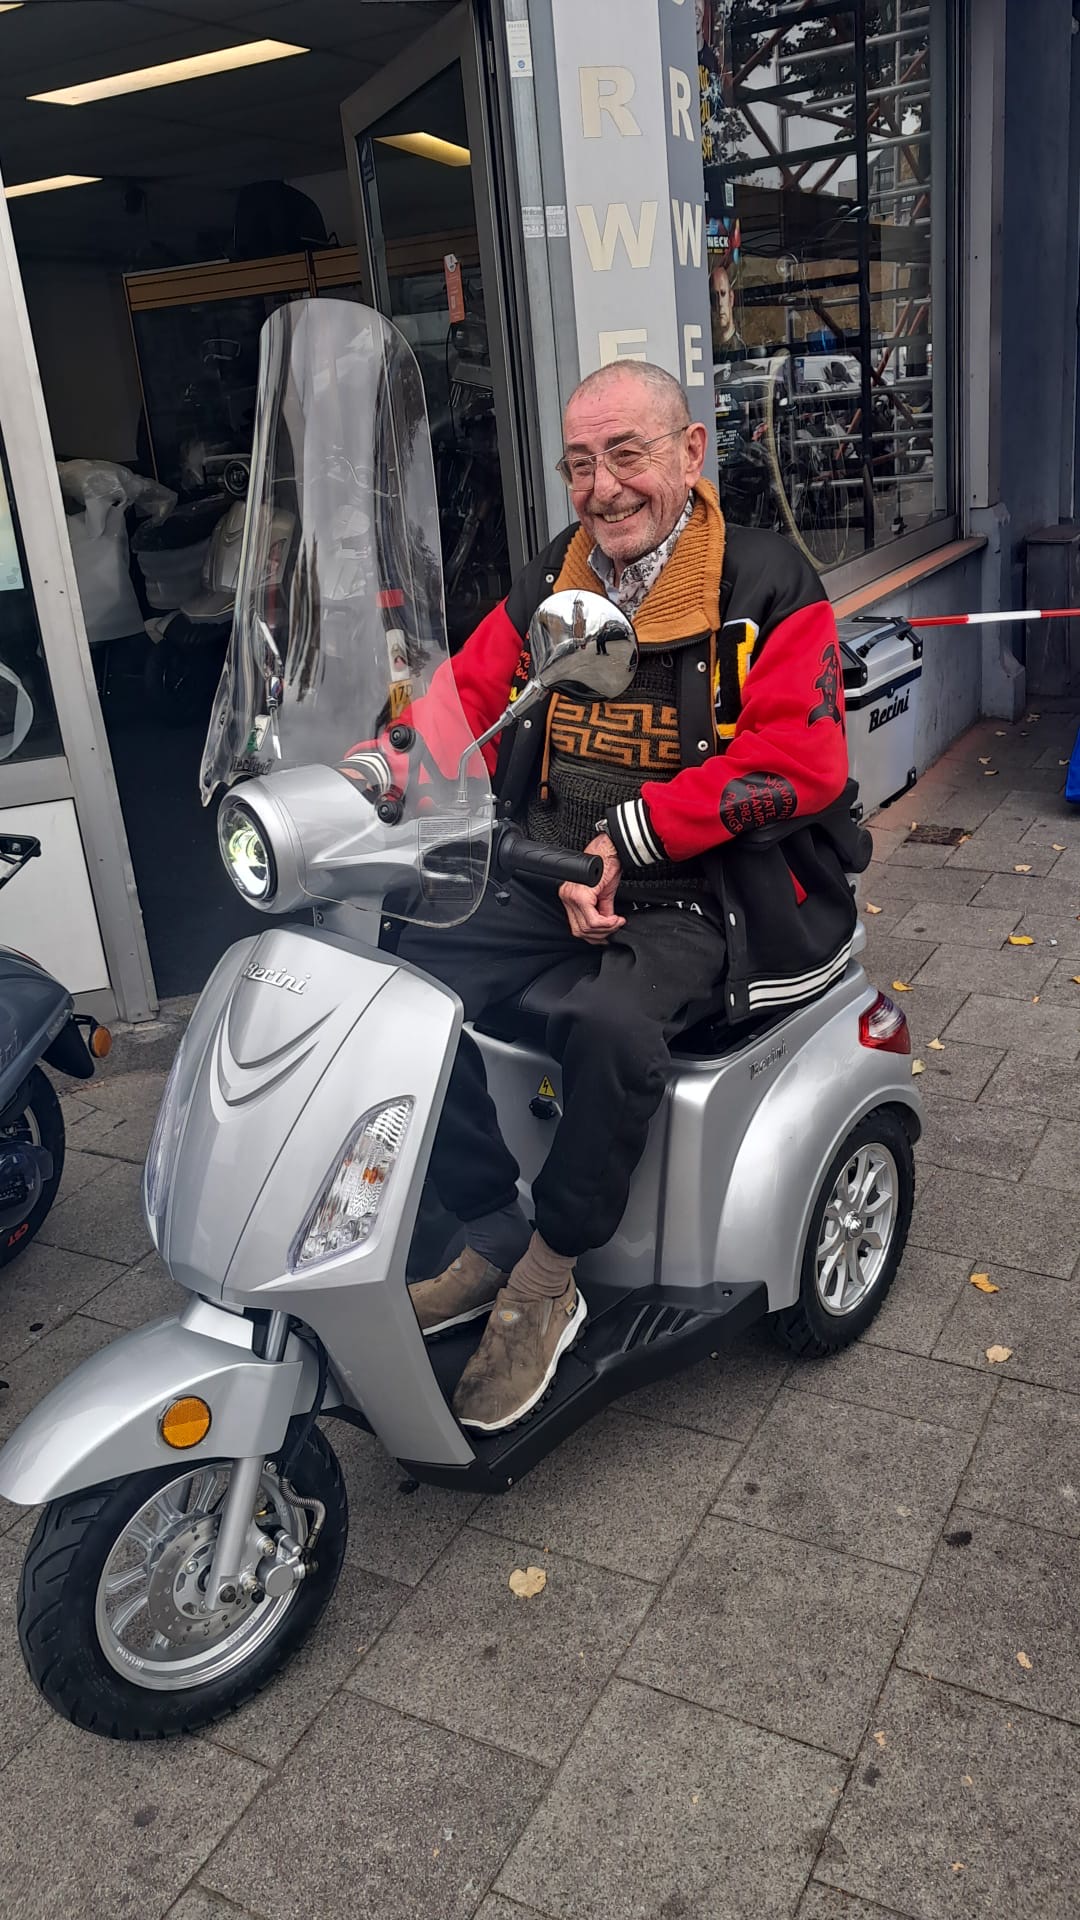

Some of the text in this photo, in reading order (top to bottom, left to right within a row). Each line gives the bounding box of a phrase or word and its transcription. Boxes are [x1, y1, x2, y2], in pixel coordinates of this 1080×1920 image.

[868, 688, 911, 734] Berini
[739, 796, 753, 824] 1982
[760, 786, 777, 819] STATE
